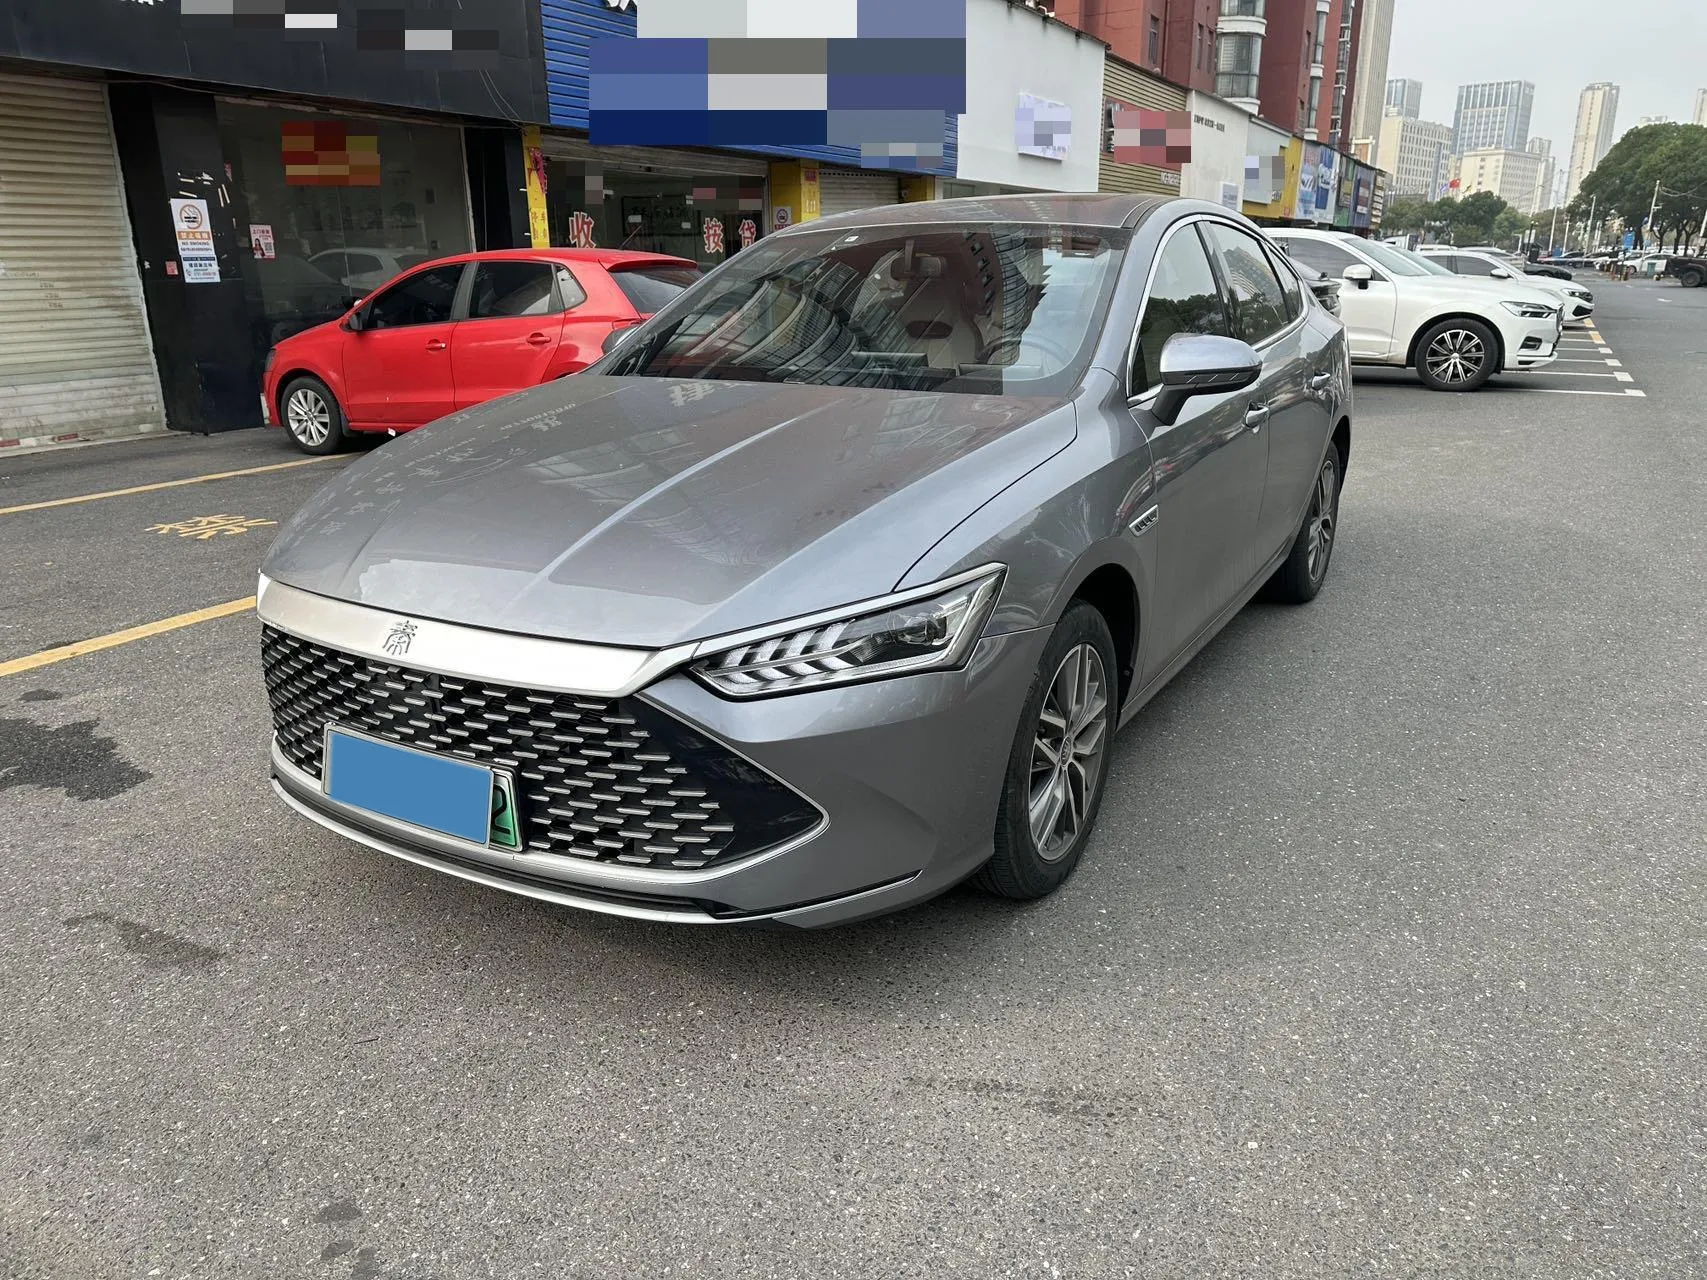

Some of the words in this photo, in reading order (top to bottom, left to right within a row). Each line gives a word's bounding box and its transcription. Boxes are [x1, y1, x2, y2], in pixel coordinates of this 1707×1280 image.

[569, 211, 597, 248] 收
[703, 217, 724, 254] 按
[144, 514, 279, 539] 禁
